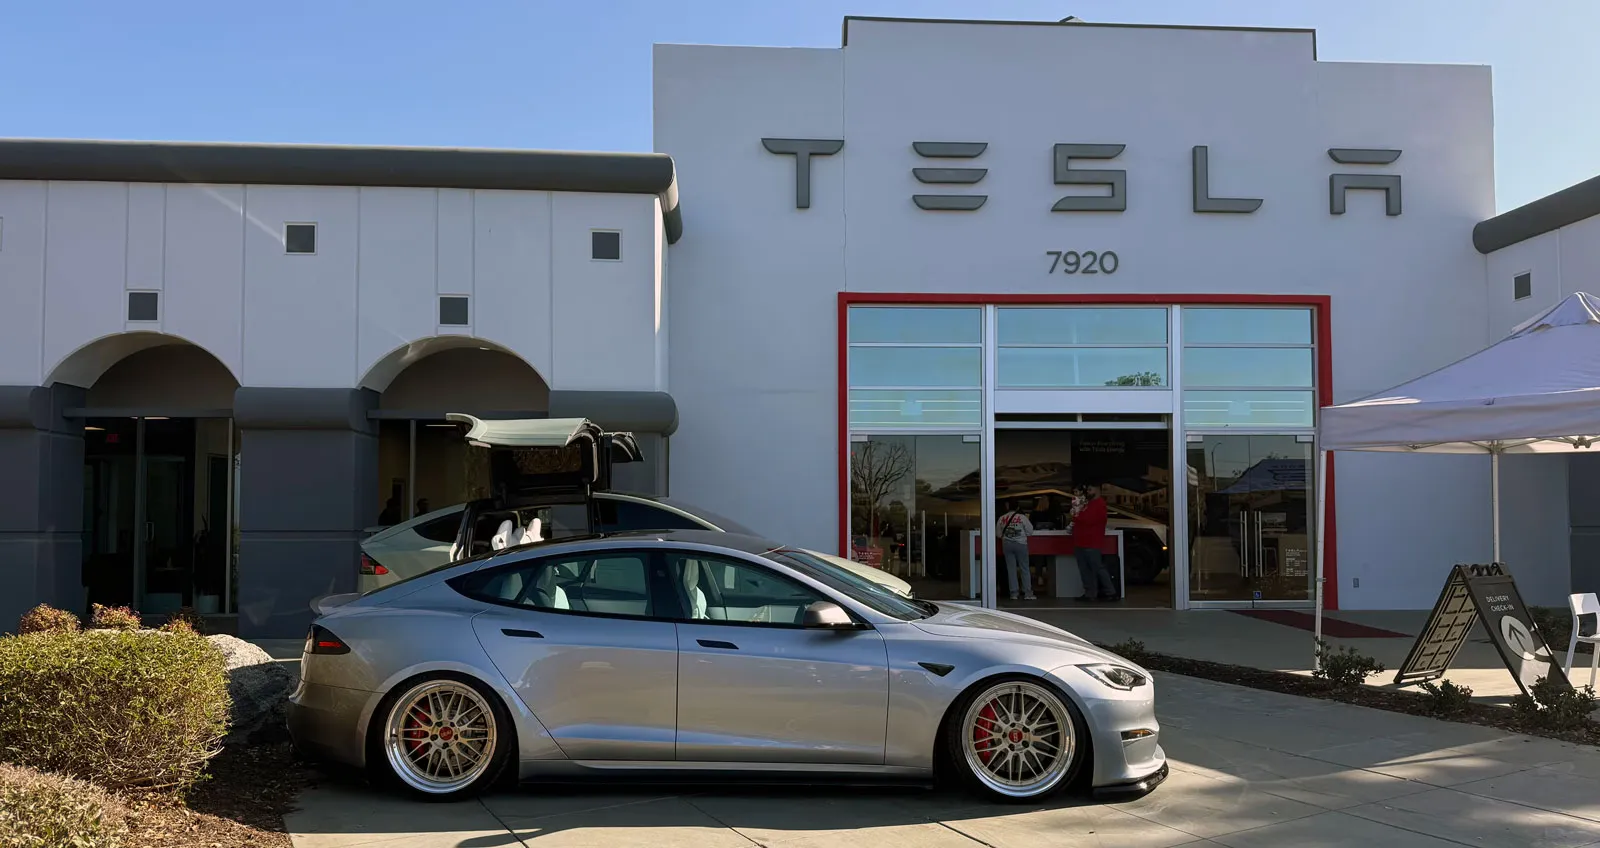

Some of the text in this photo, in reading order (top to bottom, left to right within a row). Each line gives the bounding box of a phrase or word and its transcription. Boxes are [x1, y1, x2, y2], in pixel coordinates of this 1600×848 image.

[761, 138, 1403, 216] TESLA
[1046, 250, 1120, 275] 7920
[1485, 595, 1510, 603] DELIVERY
[1490, 604, 1515, 612] CHECK-IN
